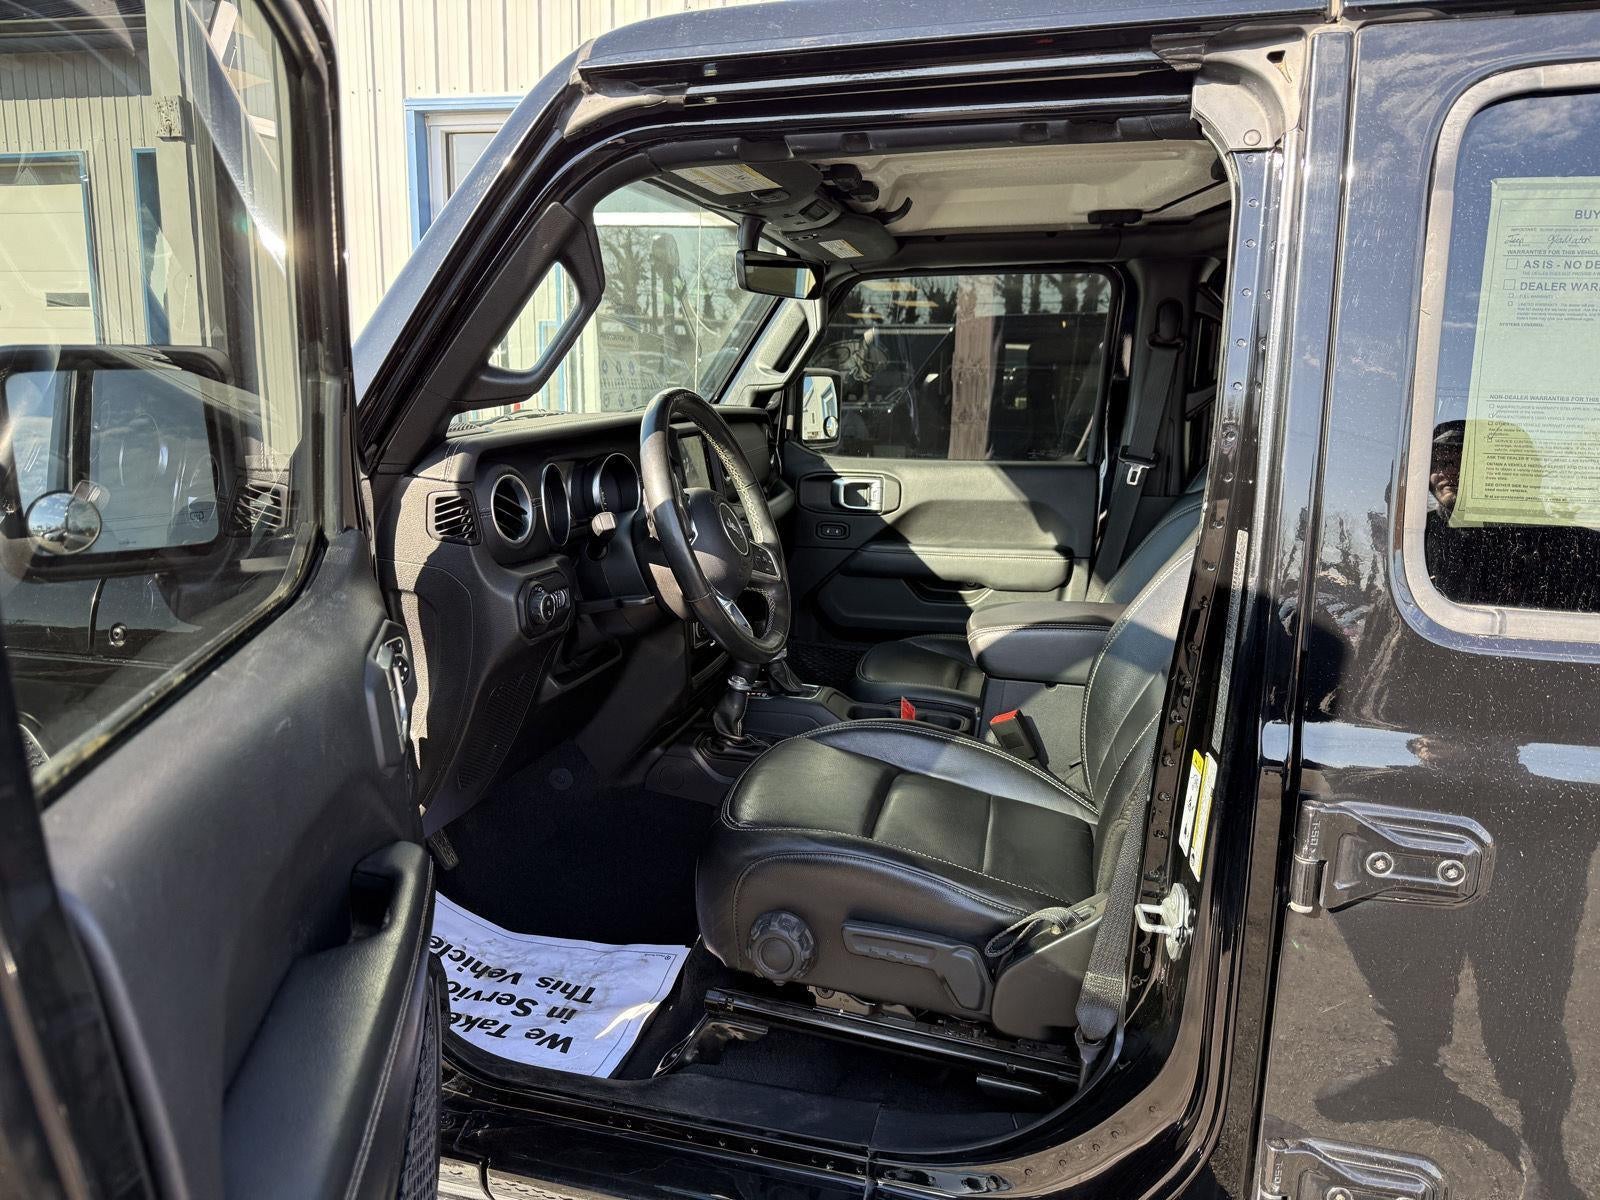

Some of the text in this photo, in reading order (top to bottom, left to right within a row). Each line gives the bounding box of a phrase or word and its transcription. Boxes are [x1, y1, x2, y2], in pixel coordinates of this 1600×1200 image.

[1574, 209, 1600, 220] BUY
[1523, 260, 1540, 269] AS
[1542, 260, 1554, 269] IS
[1563, 260, 1582, 269] NO
[1520, 281, 1600, 291] DEALER WAR
[535, 976, 596, 1004] This
[447, 981, 578, 1024] in Servic
[450, 1011, 576, 1054] We Take
